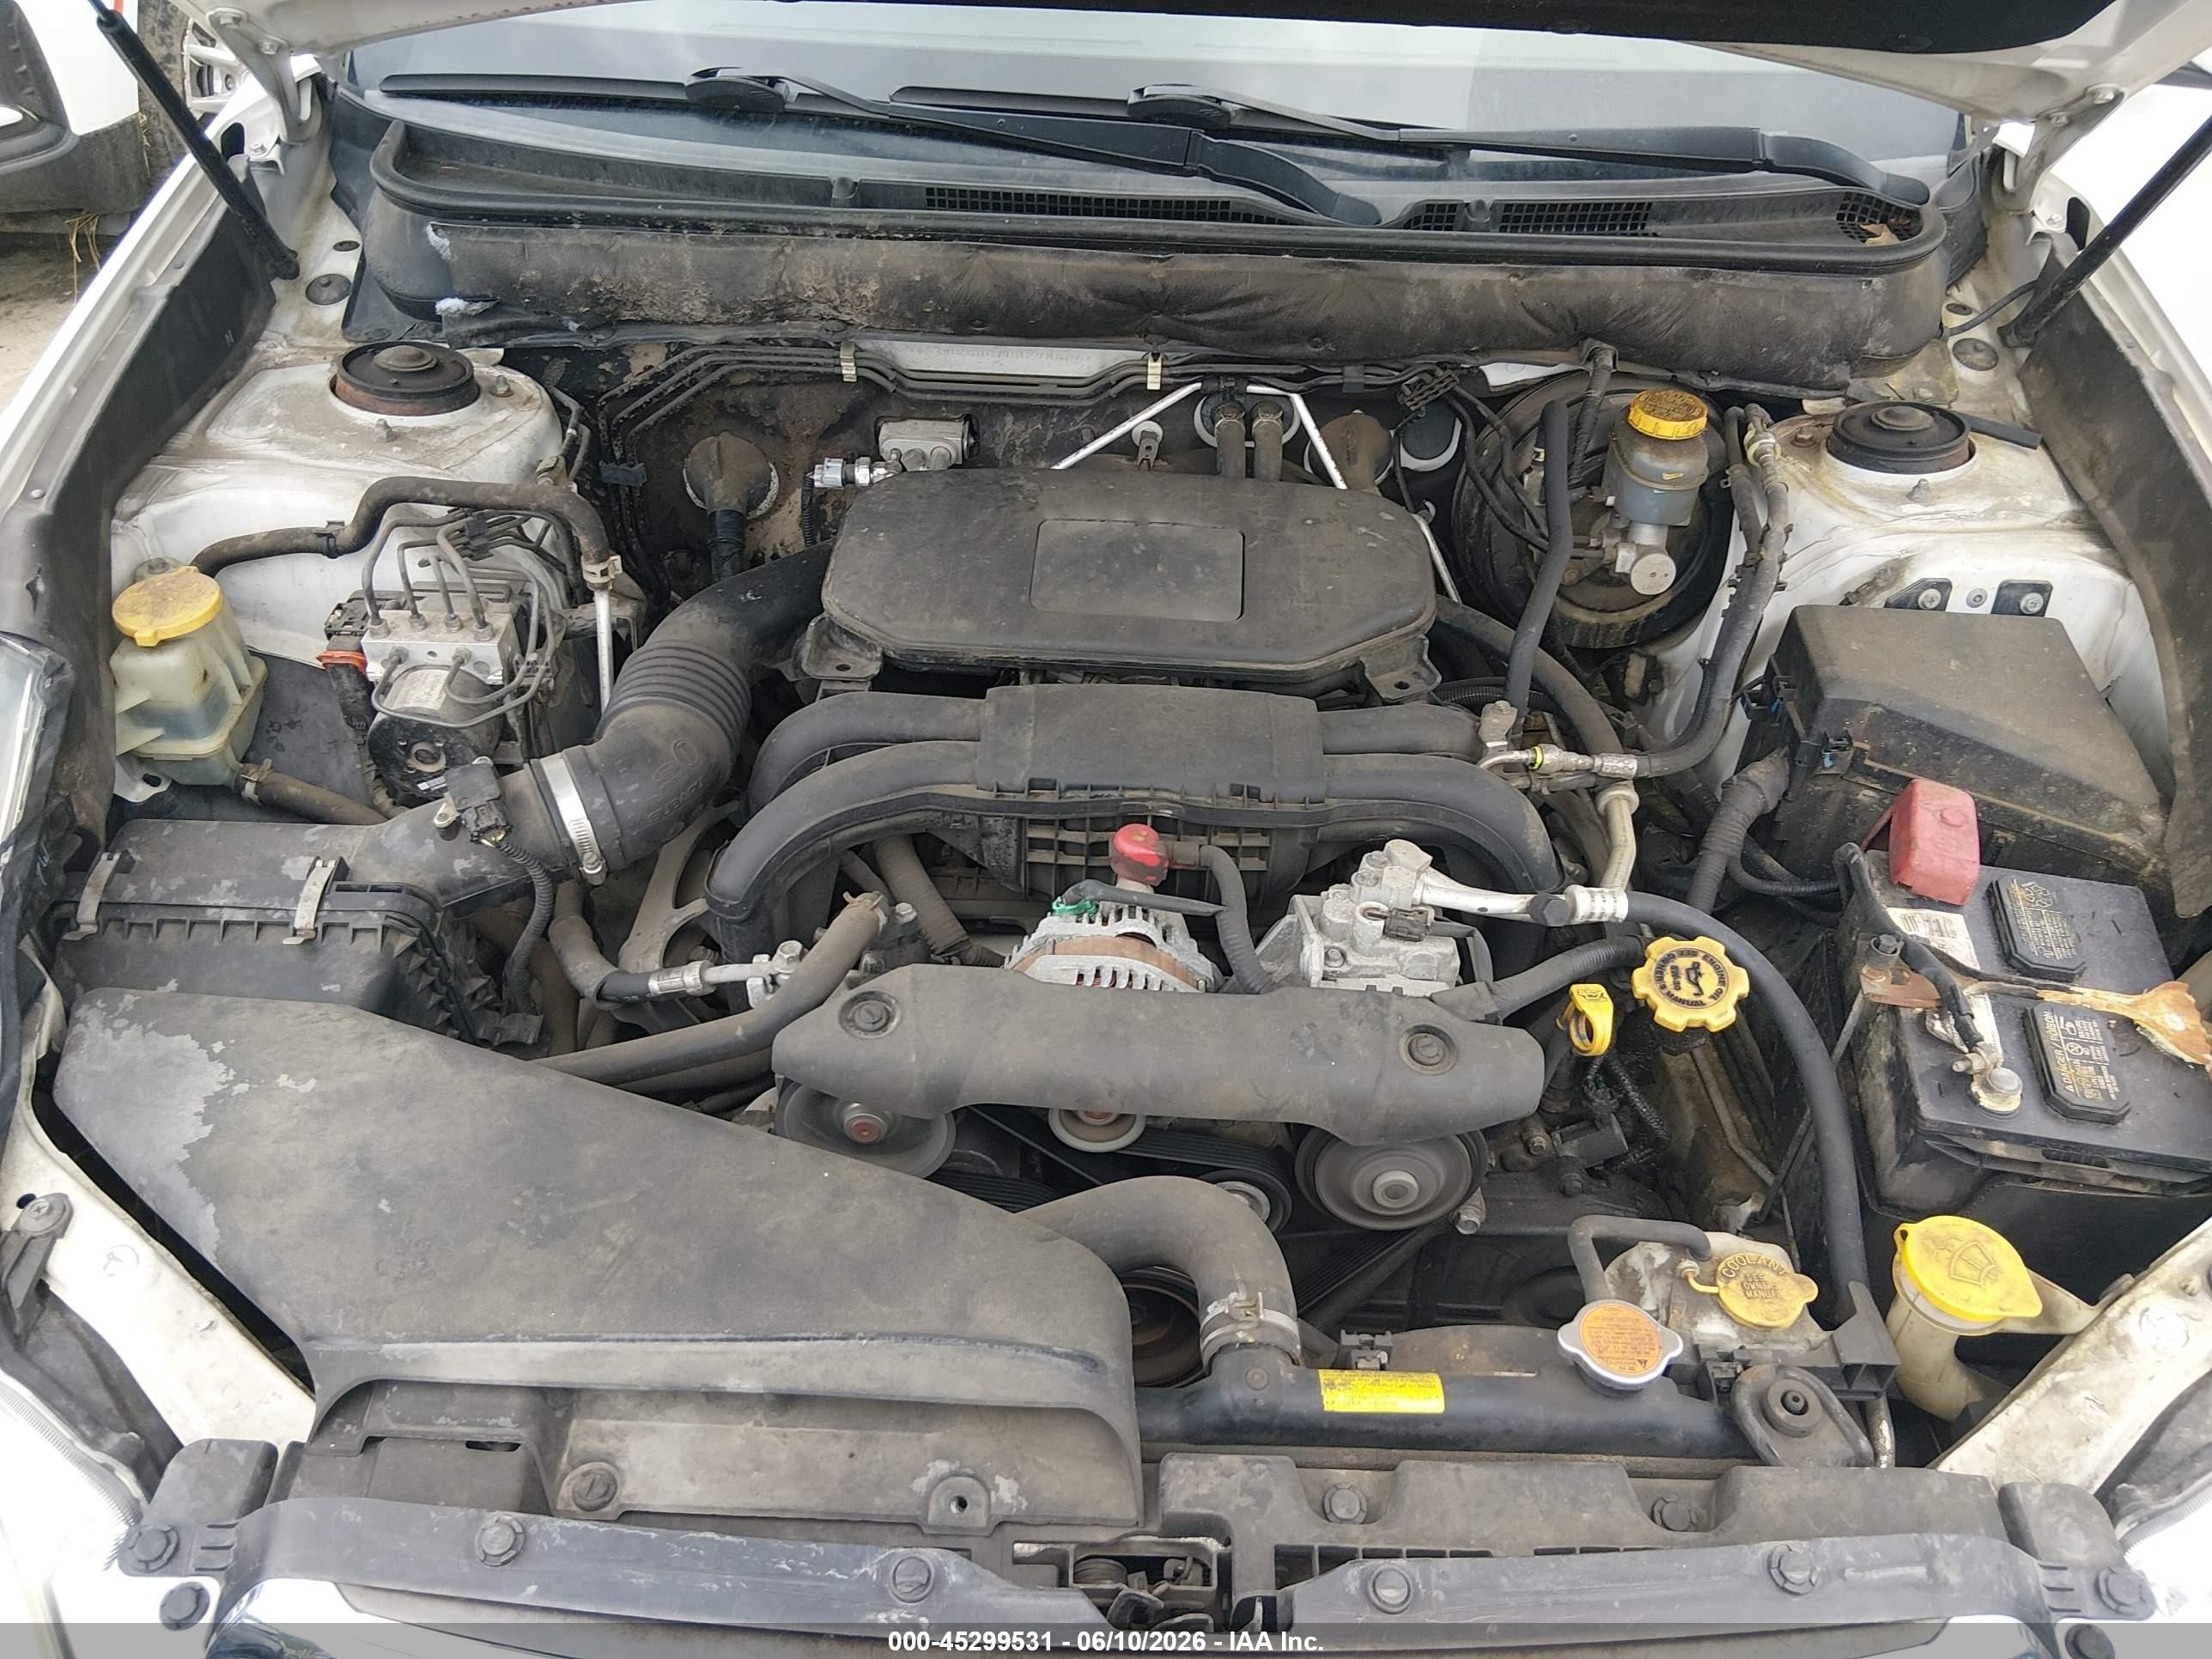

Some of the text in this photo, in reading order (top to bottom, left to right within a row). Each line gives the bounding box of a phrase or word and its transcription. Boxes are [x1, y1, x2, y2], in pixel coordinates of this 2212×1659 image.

[1702, 953, 1726, 1000] ENGINE OIL
[1665, 990, 1706, 1006] MANUAL
[2041, 1011, 2063, 1041] POISON
[2053, 1048, 2073, 1085] DANGER
[1721, 1255, 1787, 1279] COOLANT
[1744, 1272, 1766, 1282] SEE
